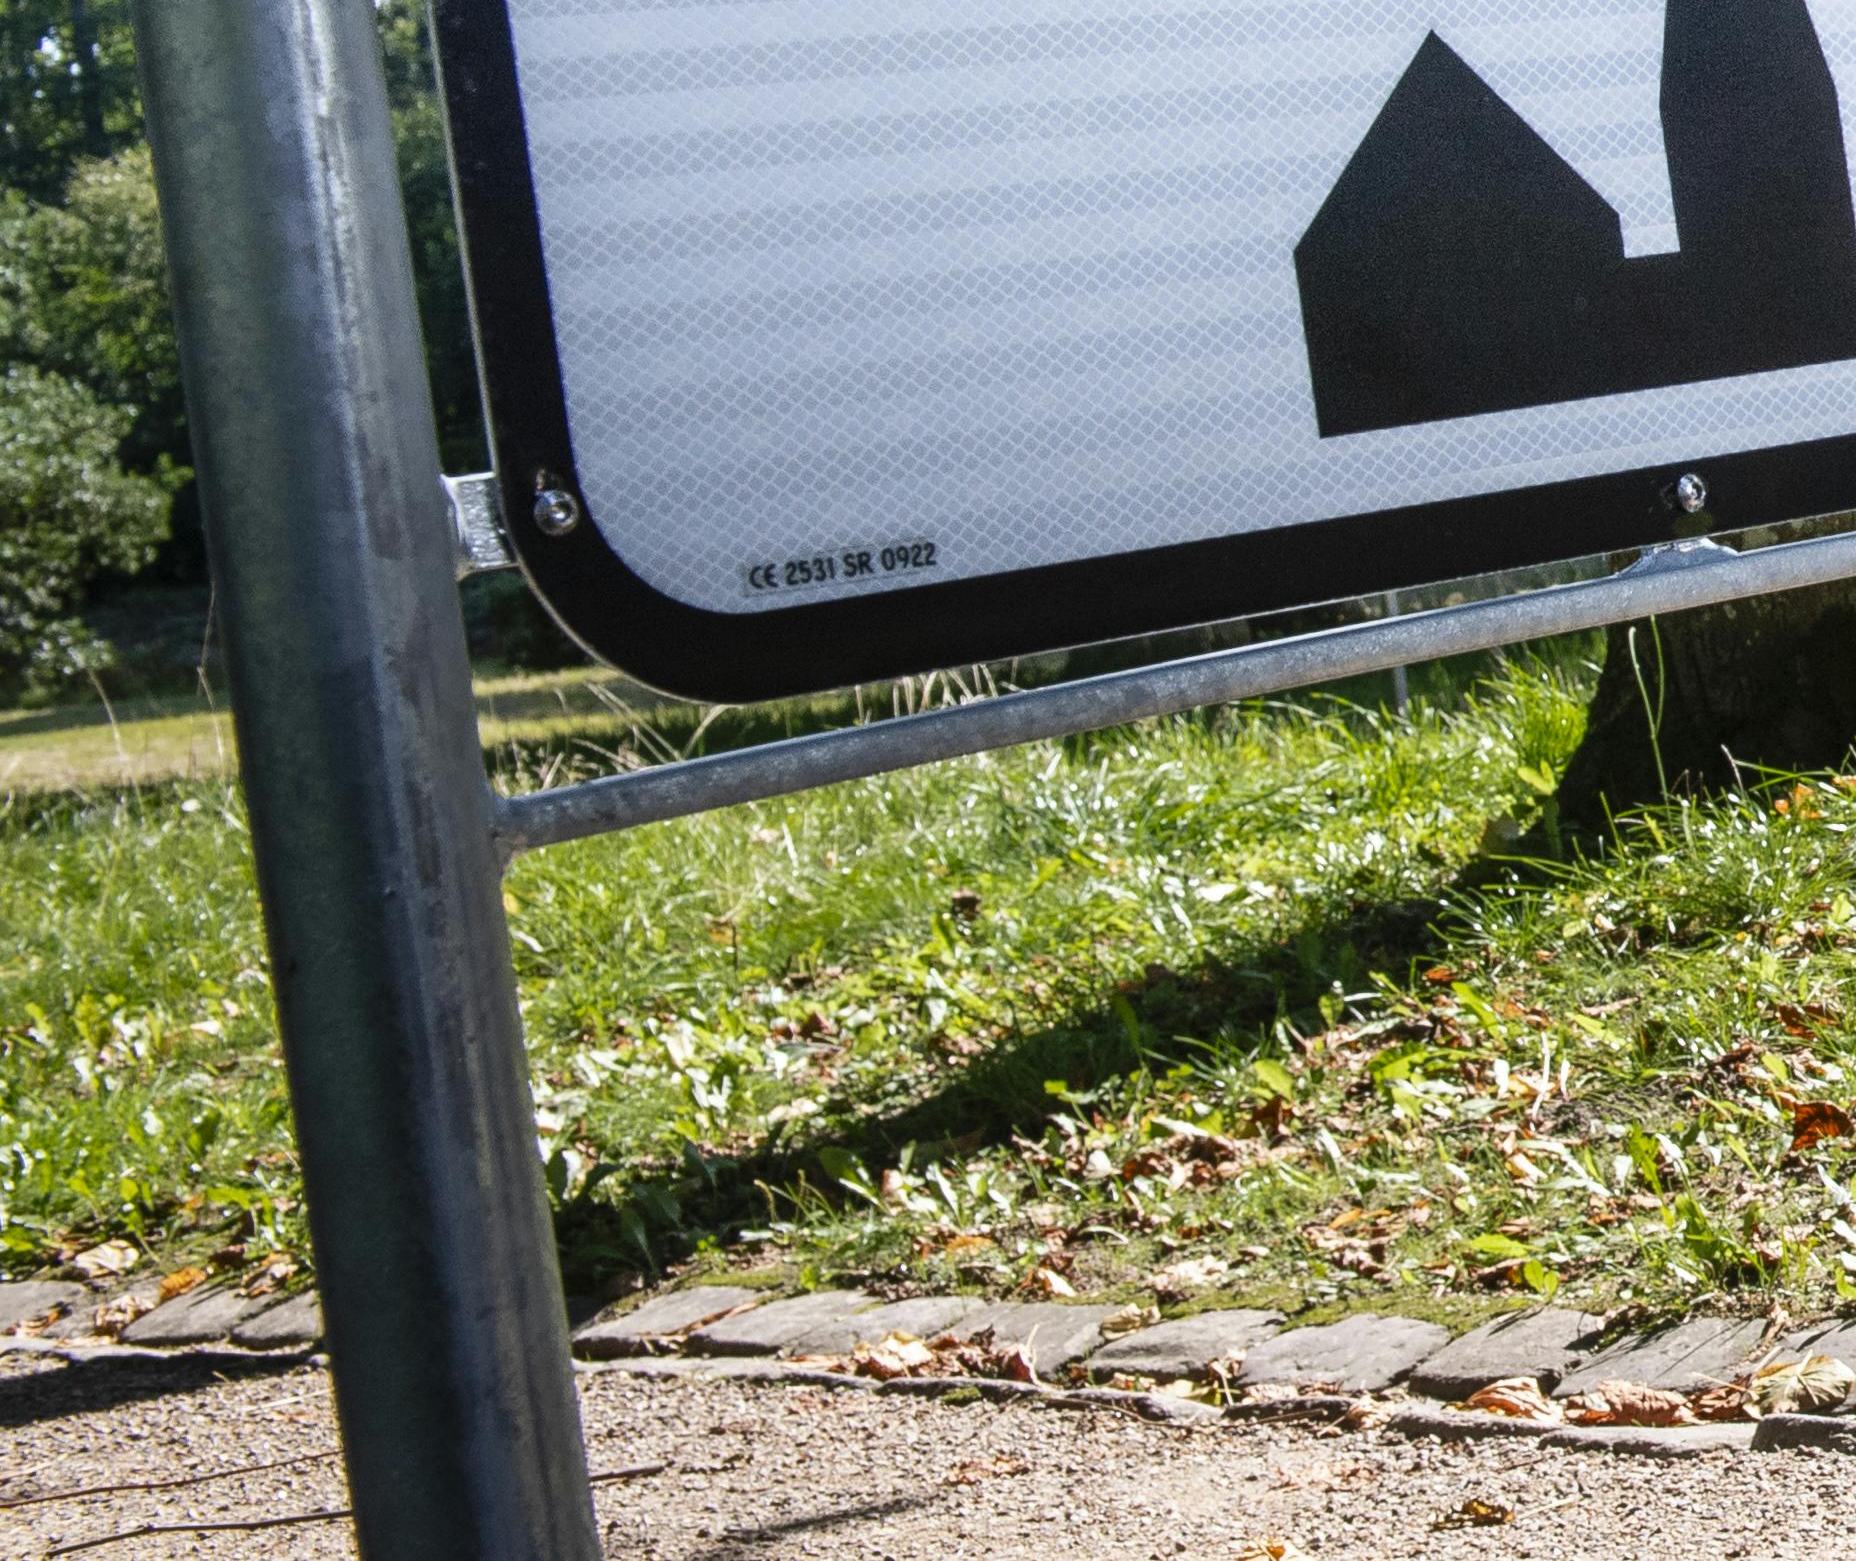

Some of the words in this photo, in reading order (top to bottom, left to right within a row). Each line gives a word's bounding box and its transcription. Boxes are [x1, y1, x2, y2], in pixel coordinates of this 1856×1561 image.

[749, 564, 779, 590] CE
[784, 556, 836, 587] 2531
[842, 550, 875, 579] SR
[880, 541, 937, 573] 0922
